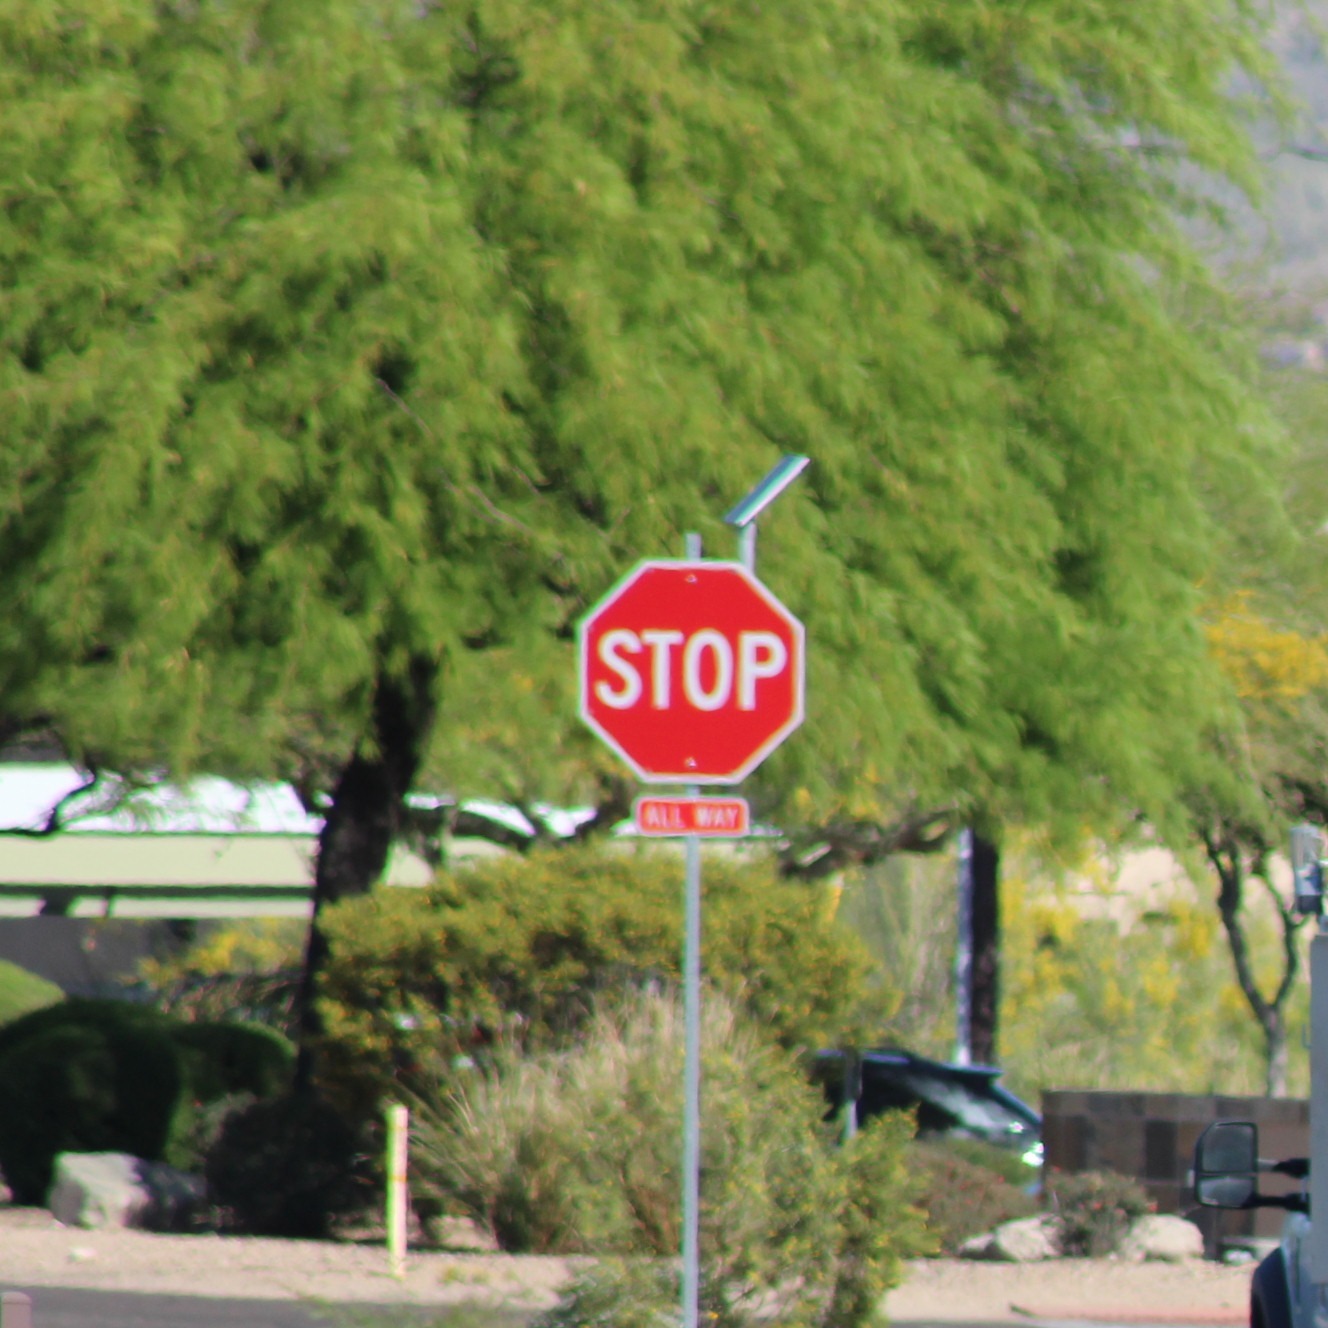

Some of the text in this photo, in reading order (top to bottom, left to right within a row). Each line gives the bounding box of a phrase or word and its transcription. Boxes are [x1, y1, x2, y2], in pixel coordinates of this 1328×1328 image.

[595, 628, 787, 712] STOP
[645, 804, 739, 828] ALL WAY
